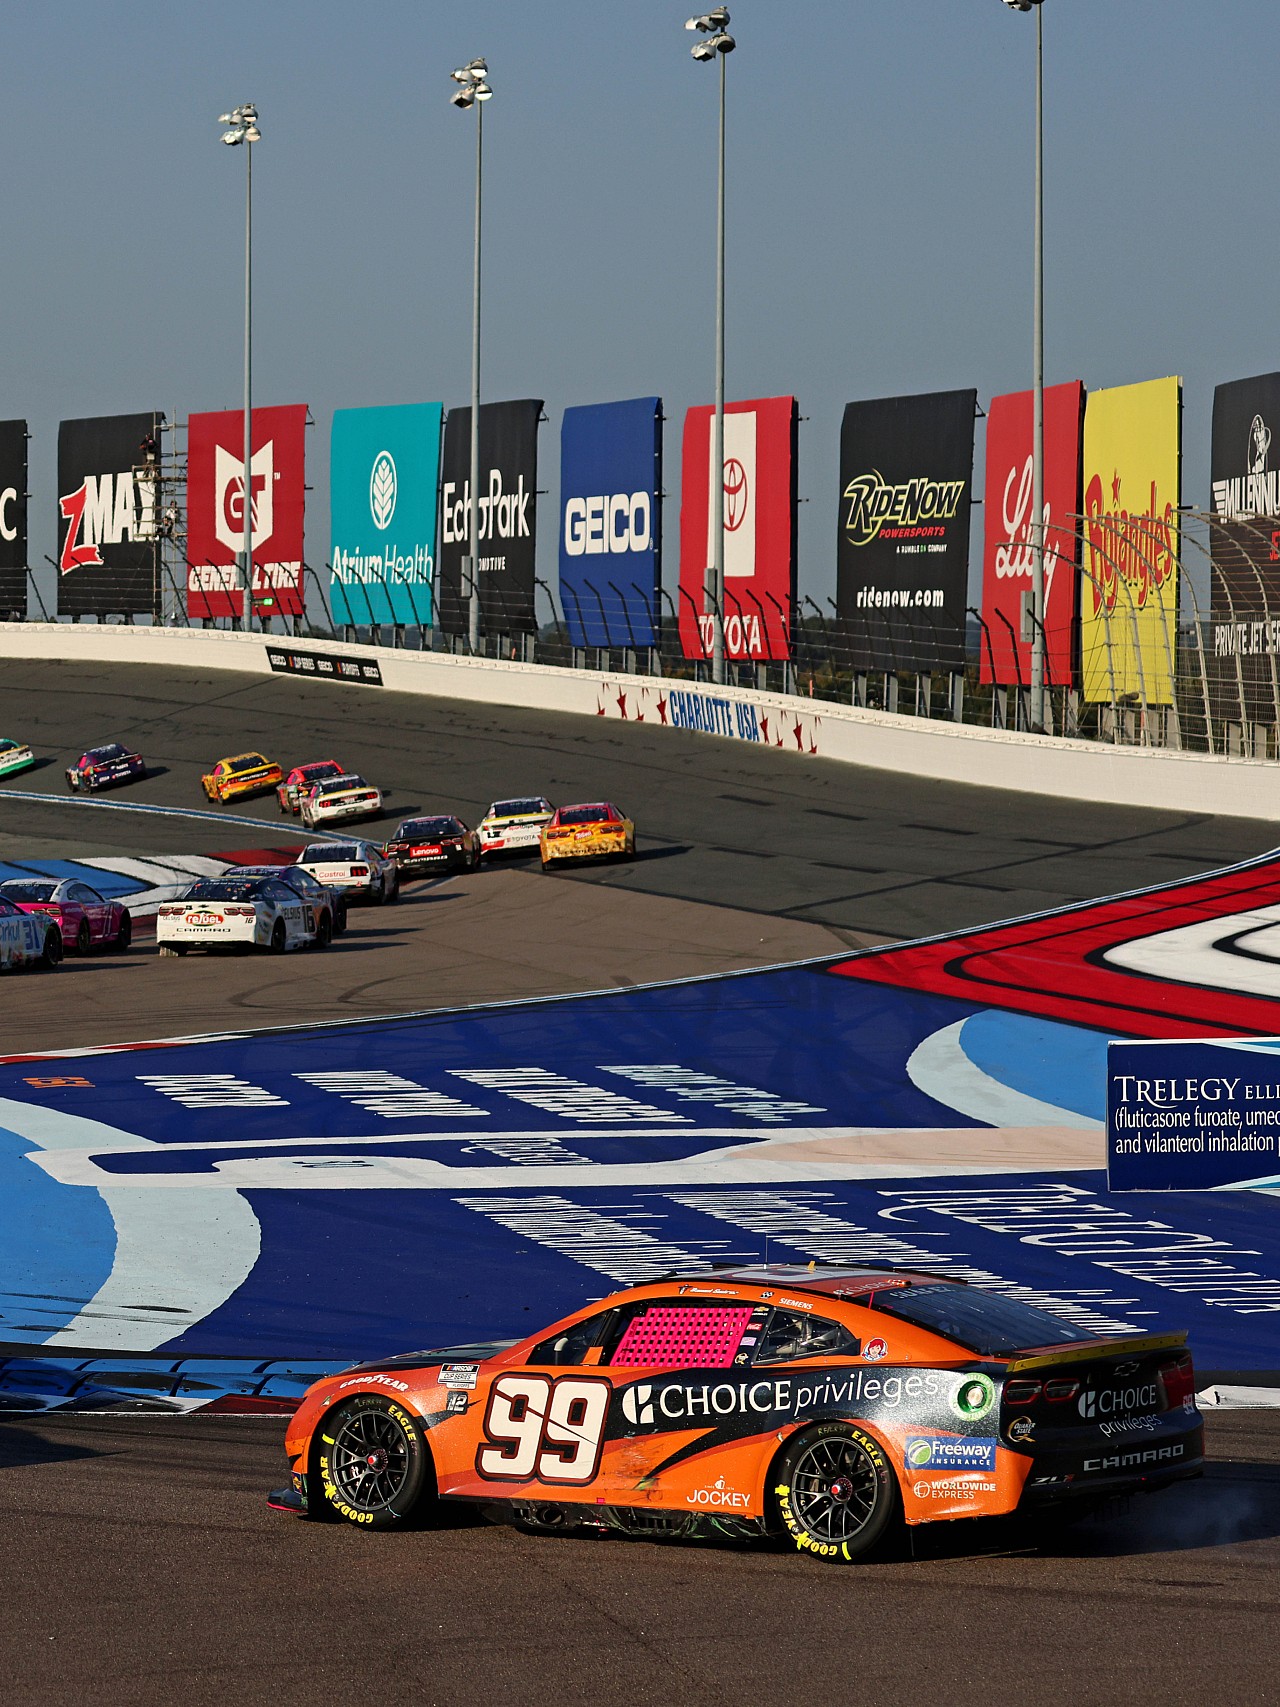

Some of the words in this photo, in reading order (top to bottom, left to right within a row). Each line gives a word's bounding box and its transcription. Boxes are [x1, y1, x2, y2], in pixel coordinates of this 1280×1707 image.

[565, 491, 651, 556] GEICO
[879, 527, 946, 539] POWERSPORTS
[263, 561, 300, 589] TIRE
[330, 546, 382, 585] Atrium
[384, 543, 434, 585] Health
[857, 586, 944, 608] ridenow.com
[1249, 621, 1264, 655] JET
[670, 690, 734, 737] CHARLOTTE
[735, 700, 760, 743] USA
[511, 834, 536, 842] TOYOTA
[412, 847, 439, 857] Lenovo
[319, 871, 346, 879] Castrol
[23, 919, 41, 951] 31
[290, 1070, 429, 1092] WITH
[444, 1066, 588, 1087] TALK
[135, 1074, 291, 1109] DOCTOR
[497, 1086, 696, 1123] TRELEGY
[1113, 1076, 1241, 1109] TRELEGY
[339, 1092, 491, 1118] YOUR
[1115, 1107, 1191, 1131] (fluticasone
[1194, 1105, 1243, 1130] furoate,
[1116, 1131, 1141, 1154] and
[1144, 1130, 1205, 1153] vilanterol
[1208, 1130, 1274, 1152] inhalation
[876, 1183, 1264, 1258] TRELEGY
[779, 1297, 814, 1310] SIEMENS
[339, 1373, 409, 1392] GOODYEAR
[659, 1380, 792, 1419] CHOICE
[793, 1371, 940, 1417] privileges
[1098, 1384, 1157, 1413] CHOICE
[1182, 1394, 1196, 1415] 99
[388, 1404, 417, 1446] EAGLE
[475, 1372, 614, 1487] 99
[1014, 1421, 1036, 1431] QUAKER
[1016, 1427, 1032, 1435] STATE
[1099, 1411, 1162, 1438] privileges
[851, 1429, 883, 1468] EAGLE
[931, 1440, 992, 1458] Freeway
[931, 1457, 991, 1466] INSURANCE
[1083, 1444, 1184, 1471] CAMARO
[320, 1455, 375, 1524] GOODYEAR
[686, 1489, 751, 1508] JOCKEY
[931, 1481, 997, 1492] WORLDWIDE
[931, 1490, 975, 1500] EXPRESS
[774, 1484, 838, 1557] GOODYEAR
